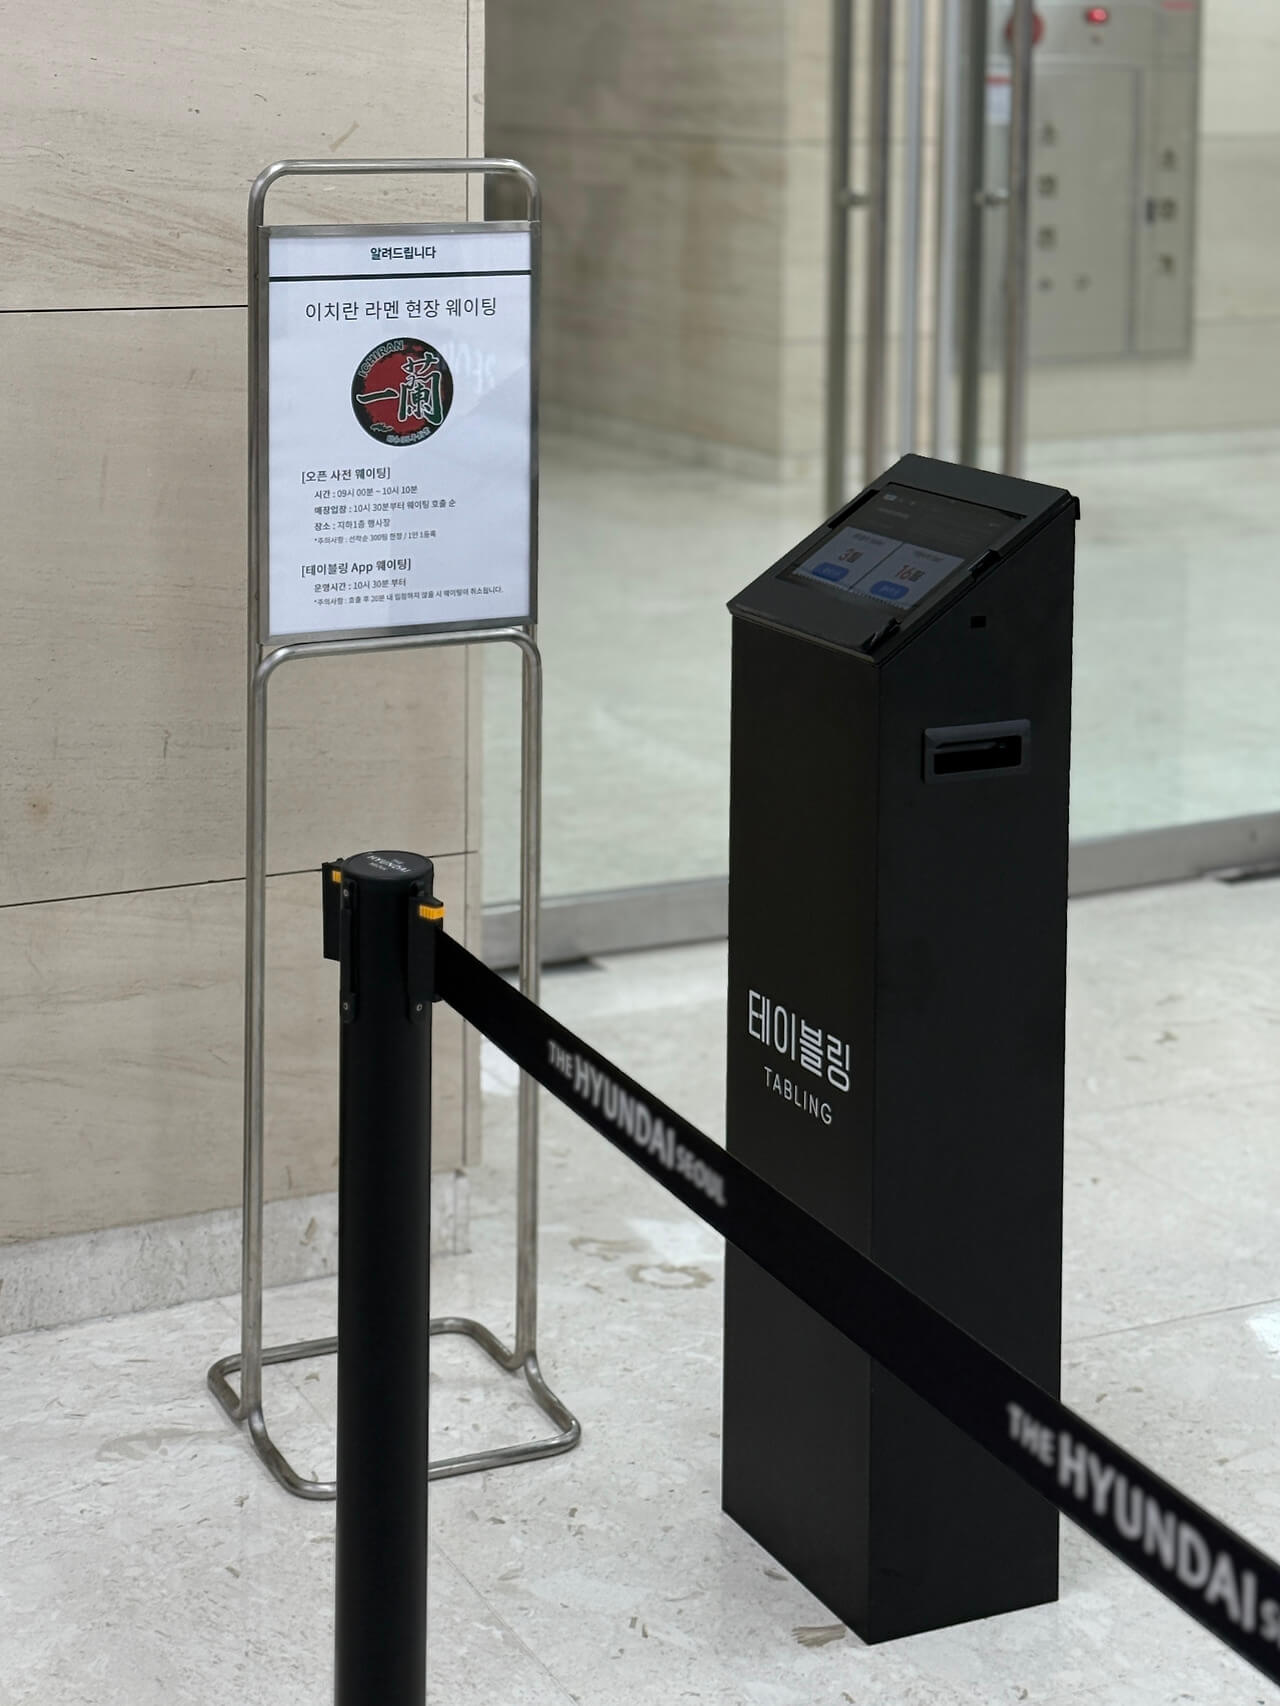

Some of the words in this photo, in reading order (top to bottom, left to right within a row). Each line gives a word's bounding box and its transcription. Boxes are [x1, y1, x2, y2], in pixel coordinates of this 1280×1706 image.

[370, 246, 436, 260] 알려드립니다
[305, 301, 359, 321] 이치란
[365, 300, 399, 320] 라멘
[406, 299, 440, 318] 현장
[446, 297, 496, 317] 웨이팅
[358, 340, 404, 378] ICHIRAN
[356, 352, 443, 425] 一蘭
[302, 470, 328, 484] [오픈
[330, 469, 352, 481] 사전
[355, 467, 391, 480] 웨이팅]
[314, 490, 330, 499] 시간
[337, 488, 355, 497] 09시
[356, 487, 374, 497] 00분
[382, 486, 399, 495] 10시
[401, 485, 418, 494] 10분
[354, 503, 370, 512] 10시
[406, 500, 430, 510] 웨이팅
[314, 522, 331, 531] 장소
[337, 520, 365, 529] 지하1층
[367, 518, 390, 528] 행사장
[302, 562, 348, 578] [테이블링
[351, 562, 373, 574] App
[376, 558, 411, 571] 웨이팅]
[314, 582, 346, 593] 운영시간
[353, 580, 370, 589] 10시
[748, 989, 851, 1093] 테이블링
[764, 1066, 833, 1125] TABLING
[548, 1039, 575, 1080] THE
[573, 1054, 677, 1170] HYUNDAI
[676, 1145, 727, 1207] SEOUL
[1007, 1401, 1056, 1467] THE
[1057, 1431, 1257, 1633] HYUNDAI
[1259, 1599, 1280, 1648] S
